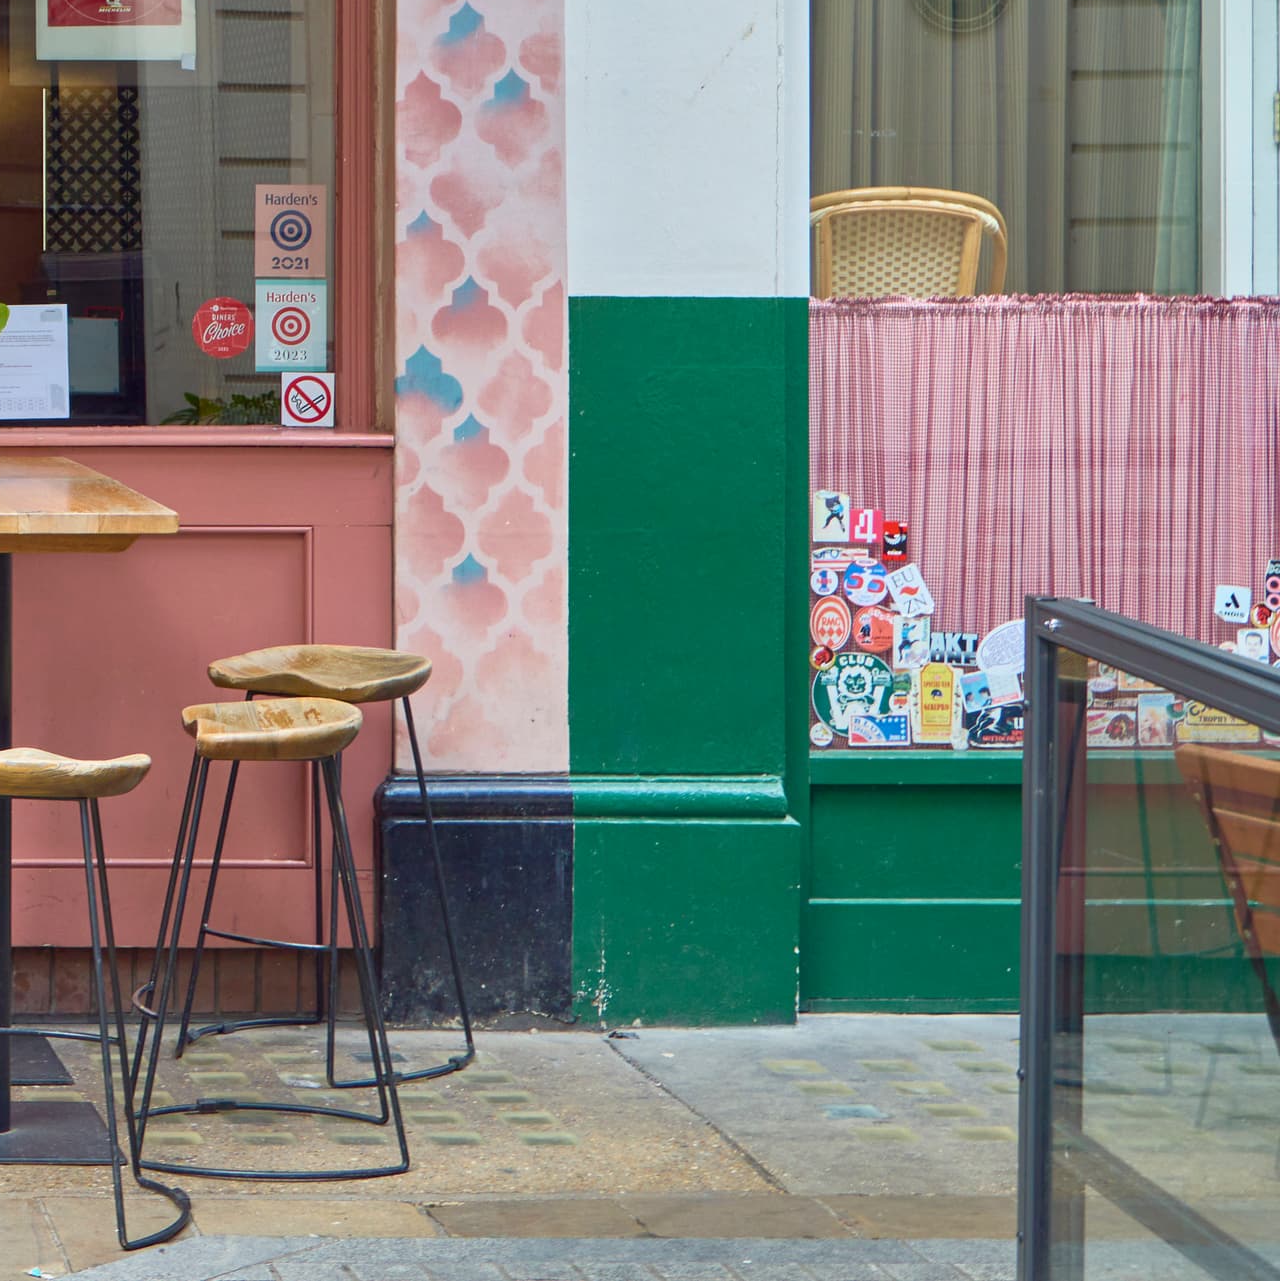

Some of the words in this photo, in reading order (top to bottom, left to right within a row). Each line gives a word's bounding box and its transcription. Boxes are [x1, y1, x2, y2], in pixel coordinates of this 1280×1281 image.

[264, 193, 318, 206] Harden's
[271, 256, 309, 270] 2021
[266, 291, 317, 303] Harden's
[202, 320, 246, 344] Choice
[273, 350, 308, 361] 2023
[838, 654, 875, 667] CLUB
